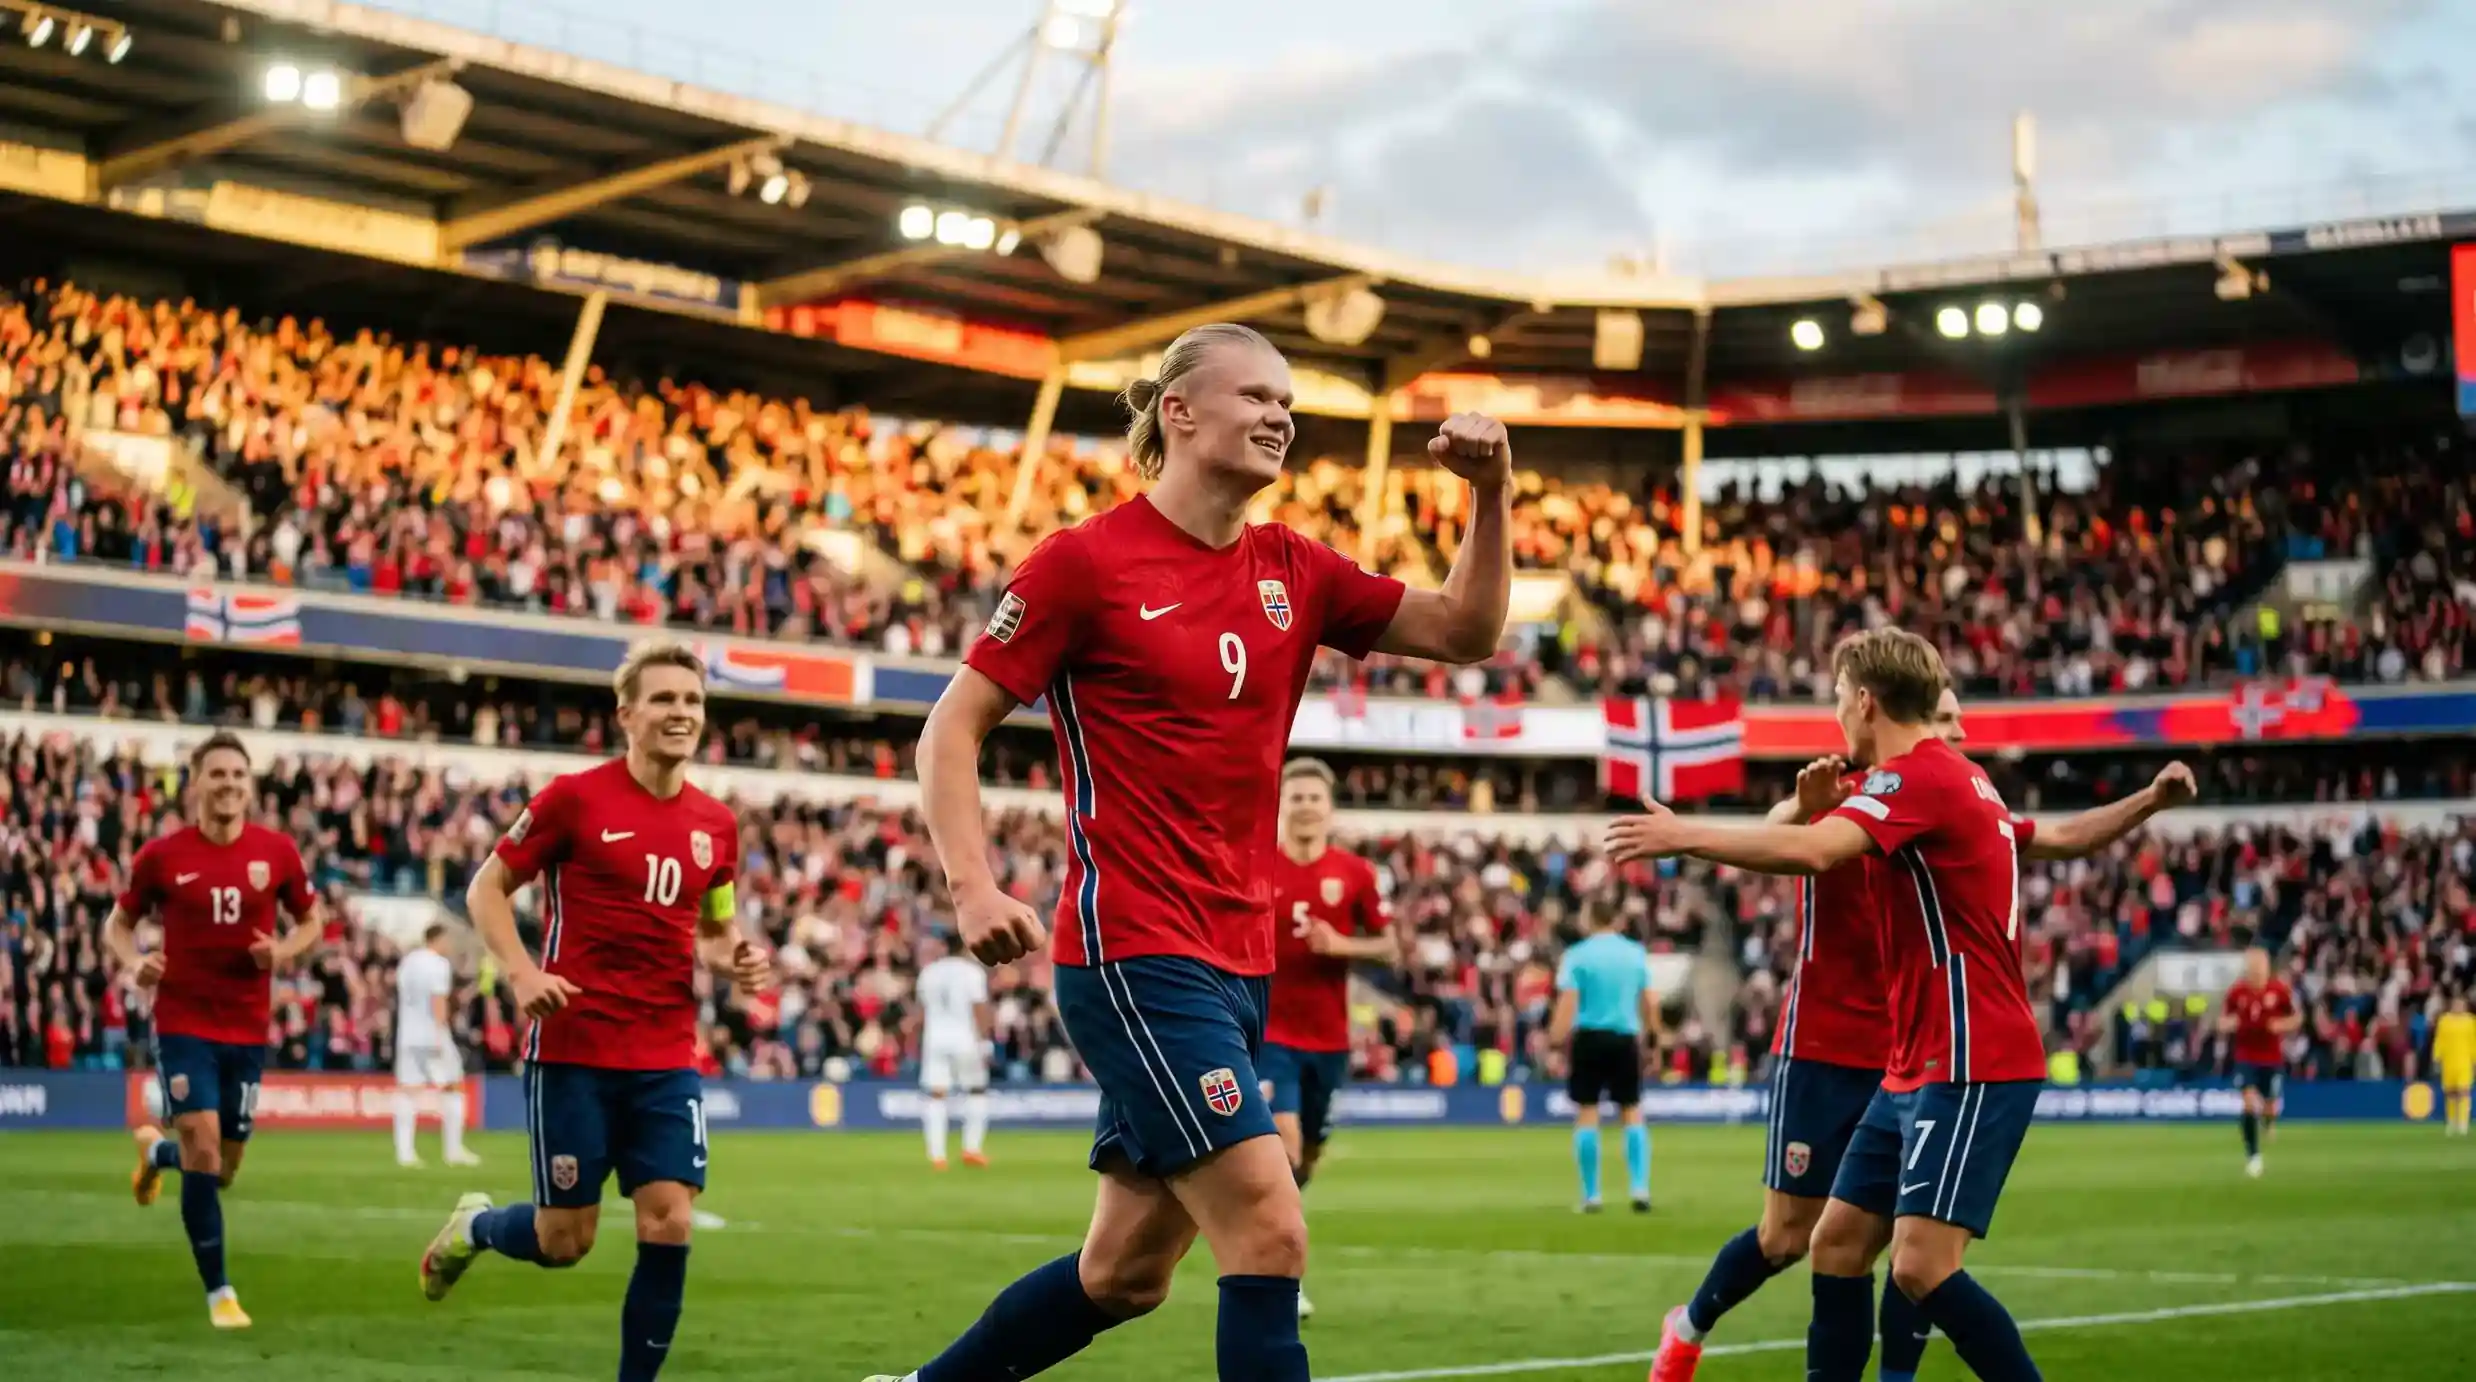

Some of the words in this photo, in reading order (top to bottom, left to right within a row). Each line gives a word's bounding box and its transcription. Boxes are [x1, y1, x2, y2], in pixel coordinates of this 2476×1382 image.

[1219, 632, 1247, 700] 9
[645, 853, 682, 906] 10
[1998, 819, 2019, 941] 7
[210, 886, 241, 925] 13
[1292, 901, 1310, 938] 5
[1907, 1120, 1937, 1170] 7
